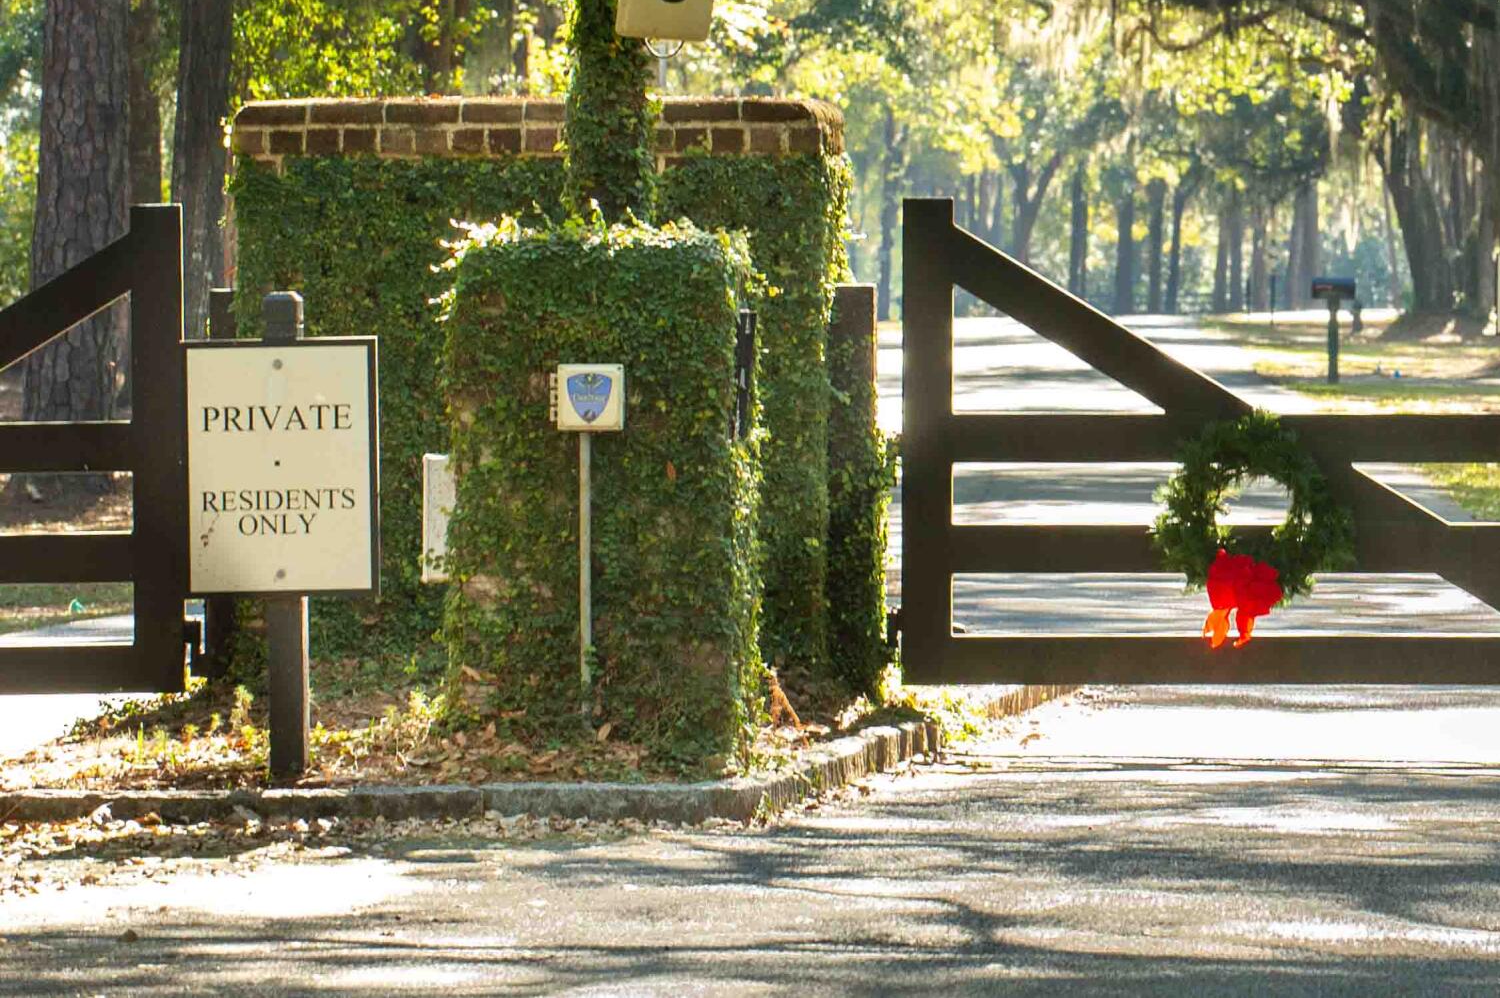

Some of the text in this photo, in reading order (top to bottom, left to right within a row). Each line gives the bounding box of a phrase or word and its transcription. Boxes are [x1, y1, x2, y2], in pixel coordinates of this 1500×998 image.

[202, 404, 352, 432] PRIVATE
[202, 488, 355, 513] RESIDENTS
[238, 513, 317, 536] ONLY
